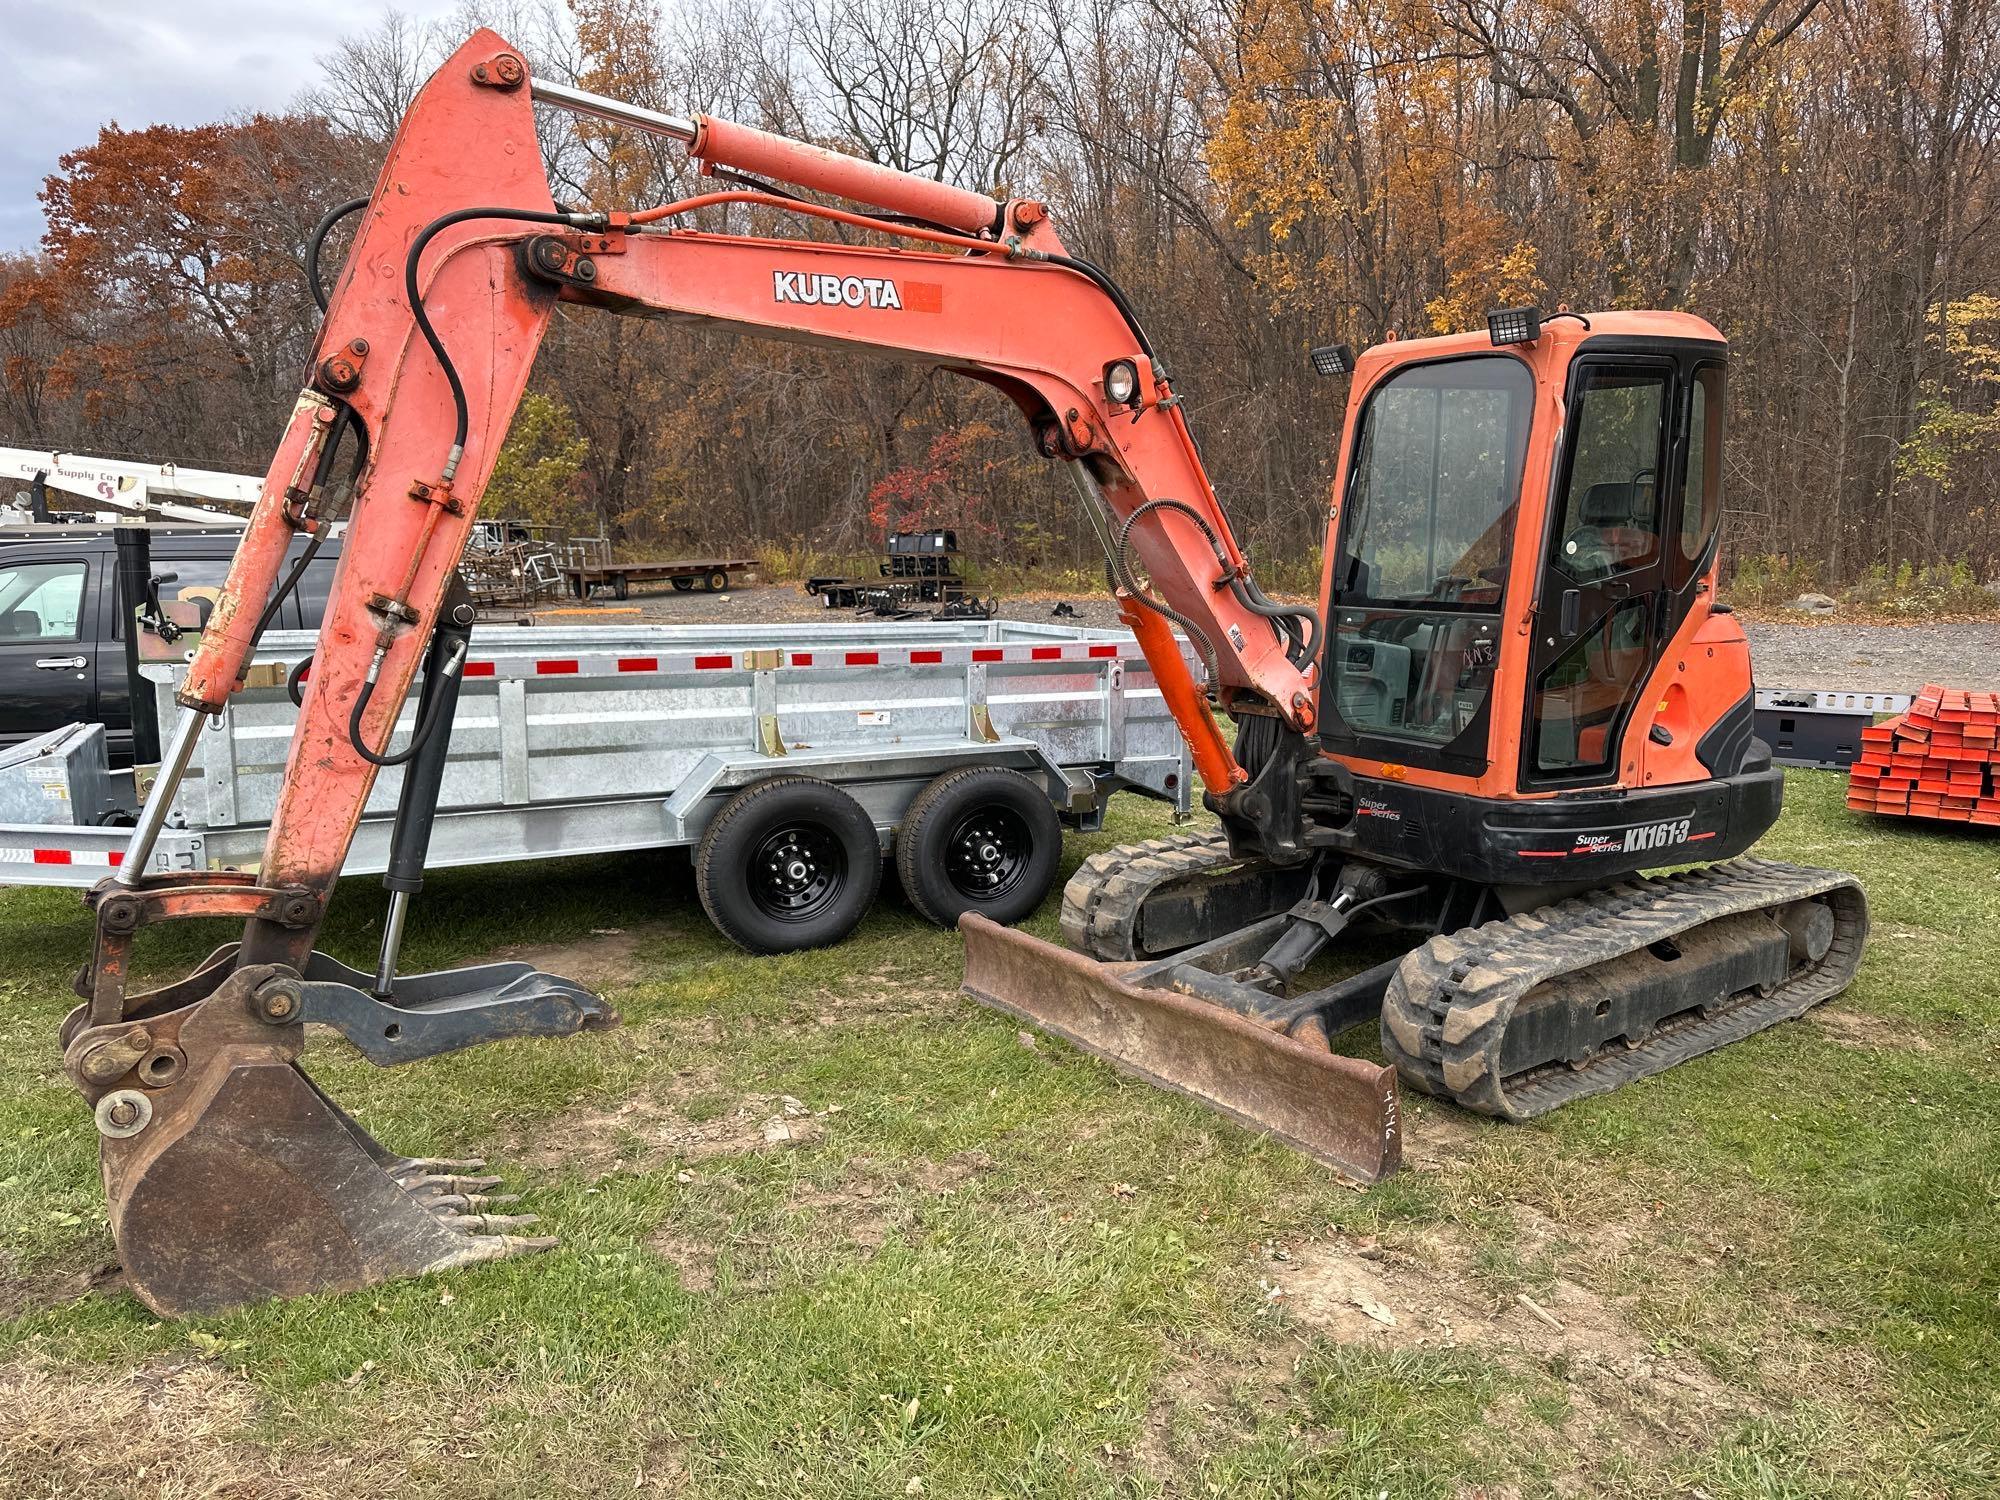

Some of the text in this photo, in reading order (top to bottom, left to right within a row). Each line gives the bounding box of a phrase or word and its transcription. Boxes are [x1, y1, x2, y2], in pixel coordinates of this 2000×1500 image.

[773, 271, 902, 310] KUBOTA
[57, 468, 94, 480] Supply
[100, 472, 116, 482] Co.
[1359, 797, 1387, 810] Super
[1370, 808, 1401, 821] Series
[1575, 834, 1610, 846] Super
[1623, 819, 1691, 853] KX161-3
[1590, 843, 1622, 853] Series
